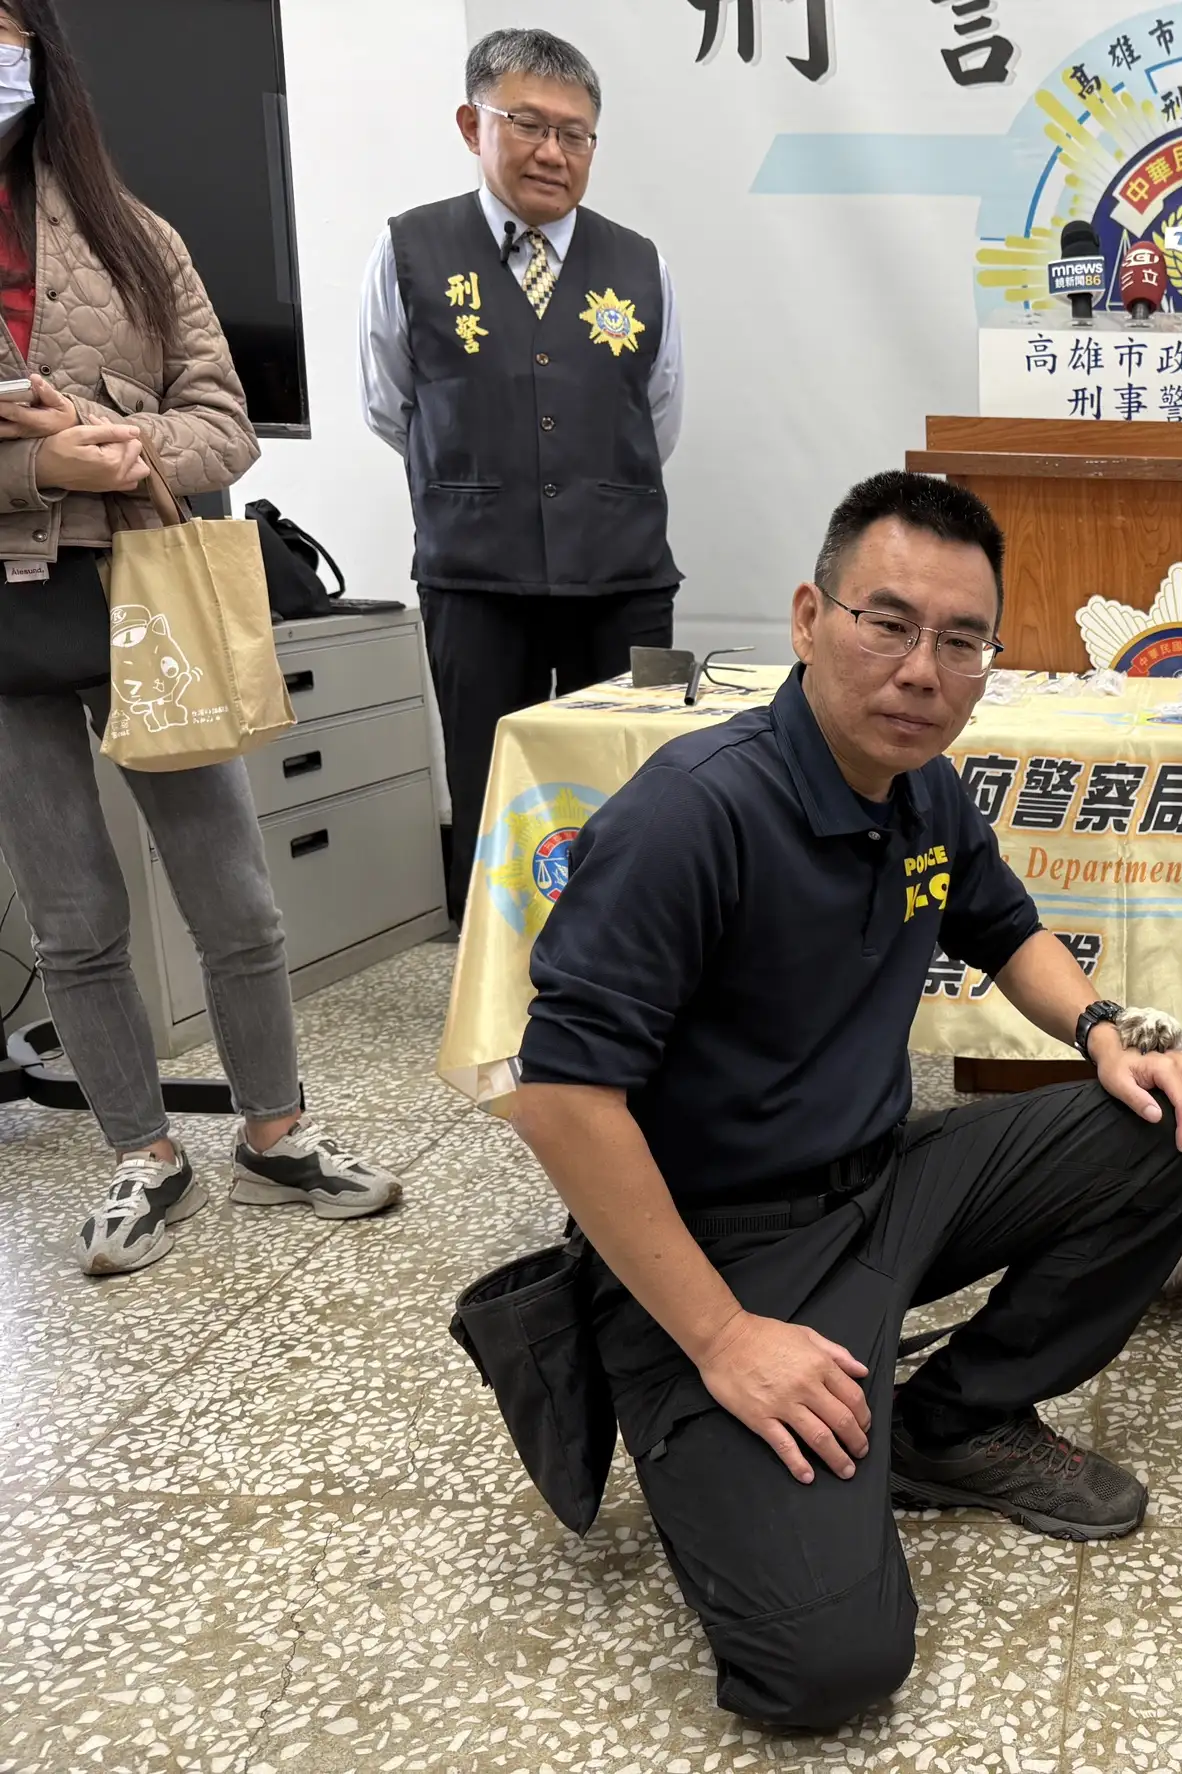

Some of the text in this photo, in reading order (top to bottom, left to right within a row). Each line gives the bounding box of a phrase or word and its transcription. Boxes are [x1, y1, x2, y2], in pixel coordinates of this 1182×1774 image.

[1052, 263, 1104, 278] mnews
[1121, 268, 1159, 291] 三立
[445, 271, 489, 354] 刑警
